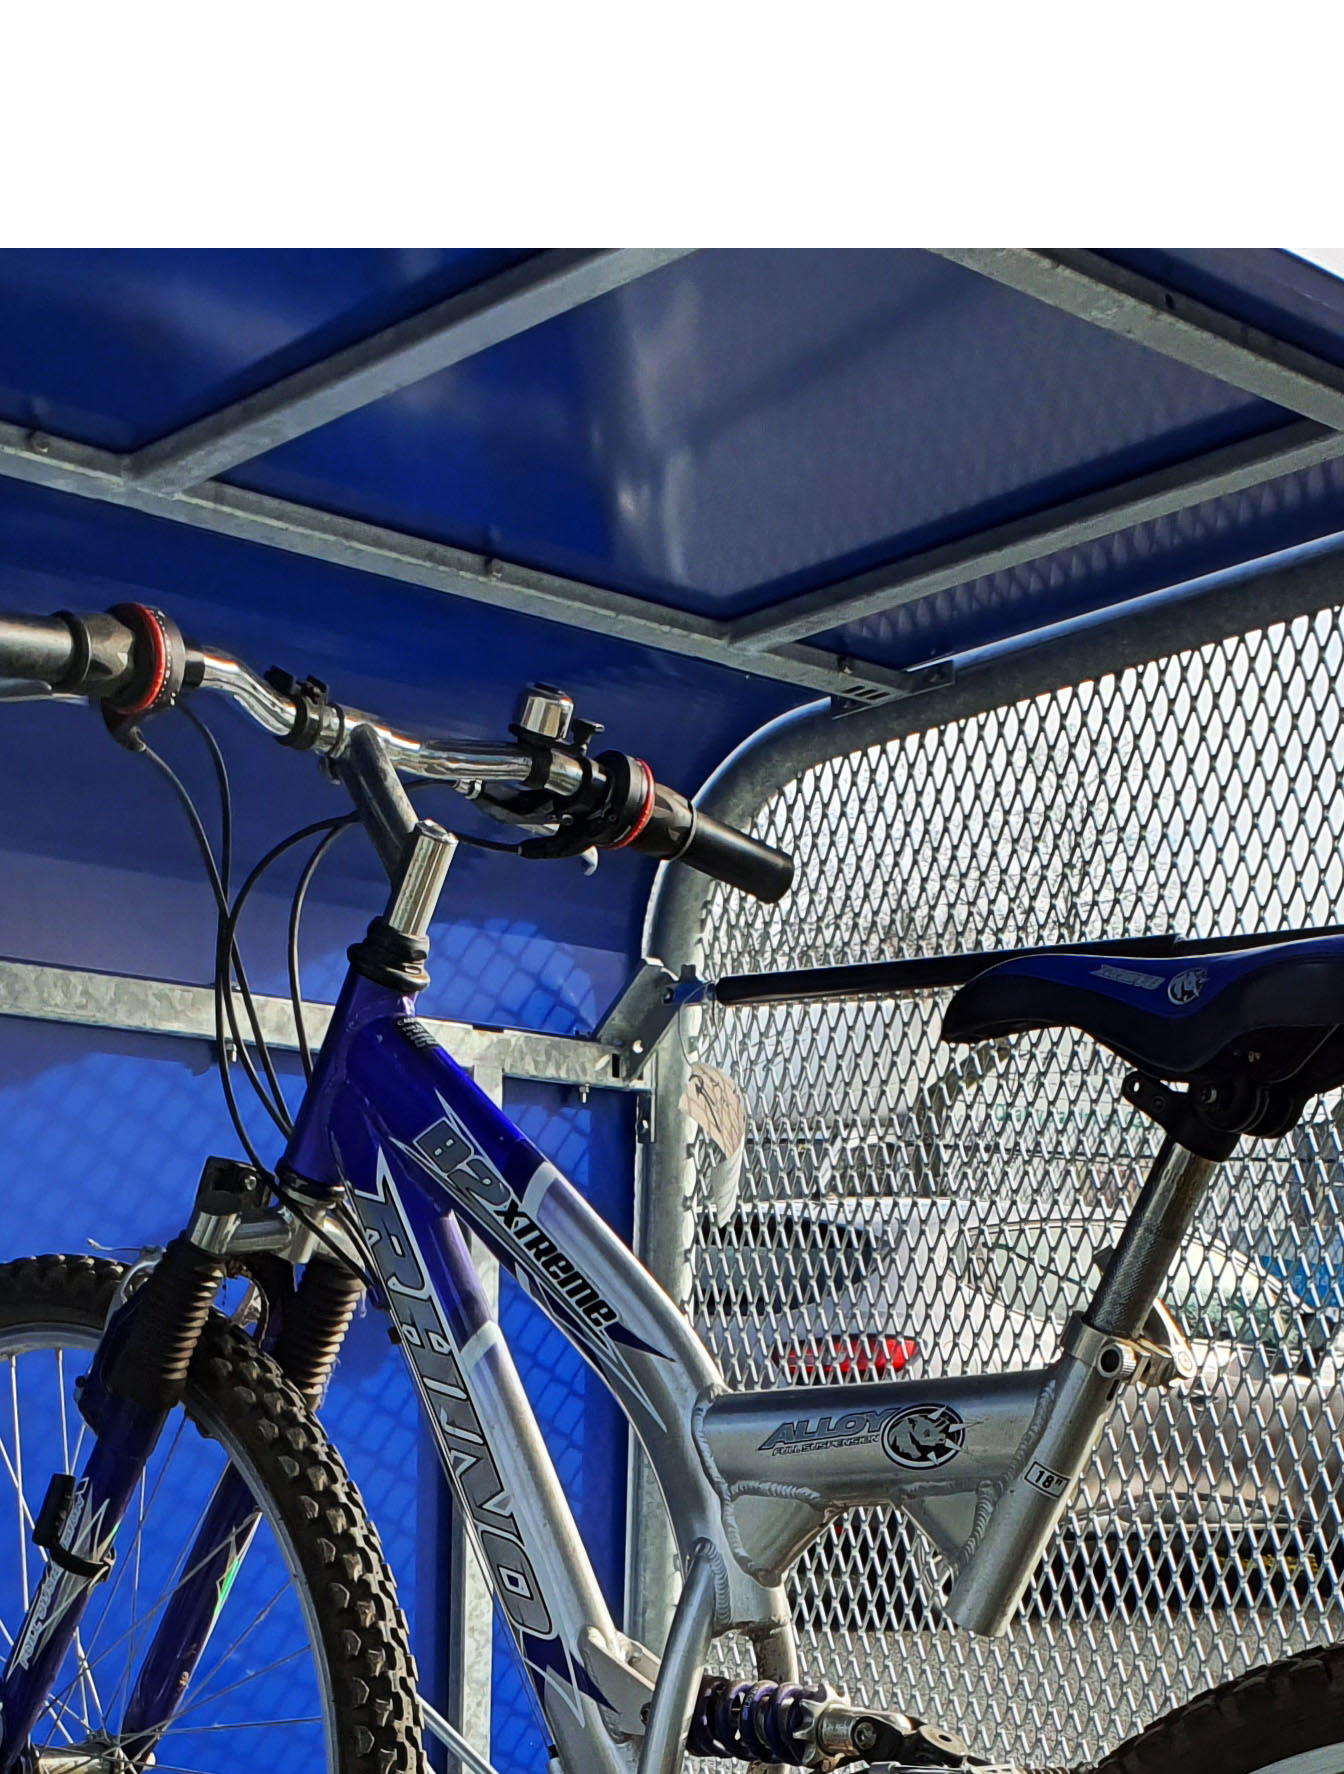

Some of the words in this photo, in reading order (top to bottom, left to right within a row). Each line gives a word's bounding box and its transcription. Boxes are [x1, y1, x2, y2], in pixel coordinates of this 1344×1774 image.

[413, 1117, 511, 1207] B2
[348, 1172, 556, 1638] RHINO
[758, 1407, 902, 1451] ALLOY
